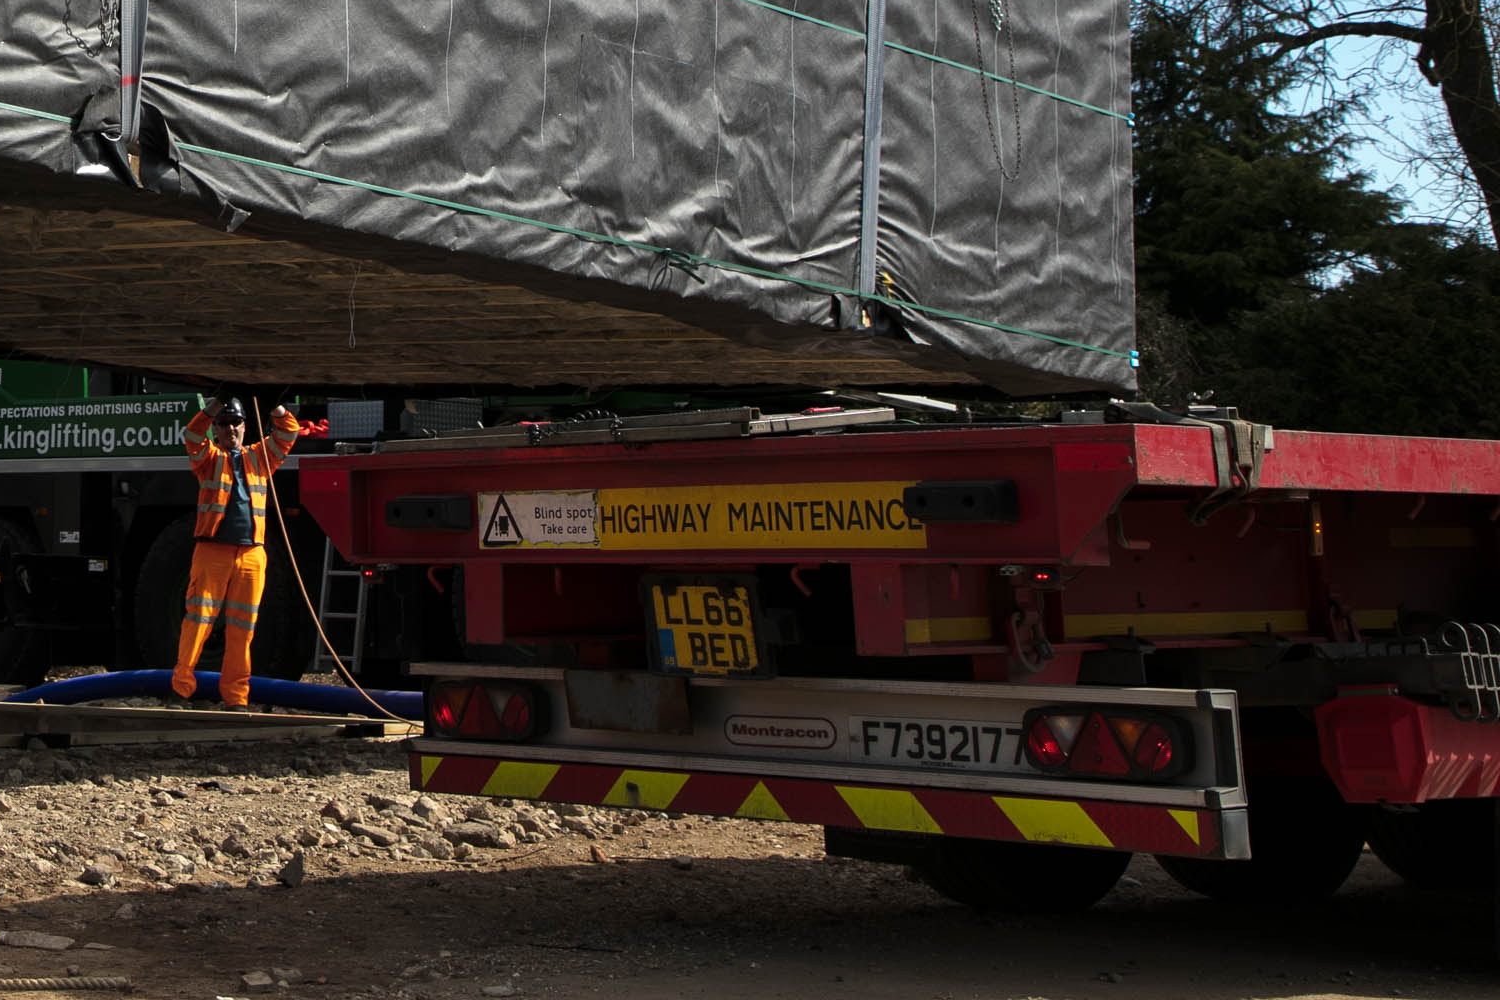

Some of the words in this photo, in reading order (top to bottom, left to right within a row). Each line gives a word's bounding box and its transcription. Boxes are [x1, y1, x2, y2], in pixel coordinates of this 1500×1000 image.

[68, 403, 142, 416] PRIORITISING
[145, 401, 189, 413] SAFETY
[534, 506, 562, 520] Blind
[566, 507, 594, 522] spot
[601, 503, 712, 534] HIGHWAY
[541, 524, 564, 535] Take
[566, 525, 588, 535] care
[661, 591, 743, 626] LL66
[688, 632, 750, 667] BED
[731, 723, 829, 739] Montracon
[862, 720, 1026, 766] F7392177
